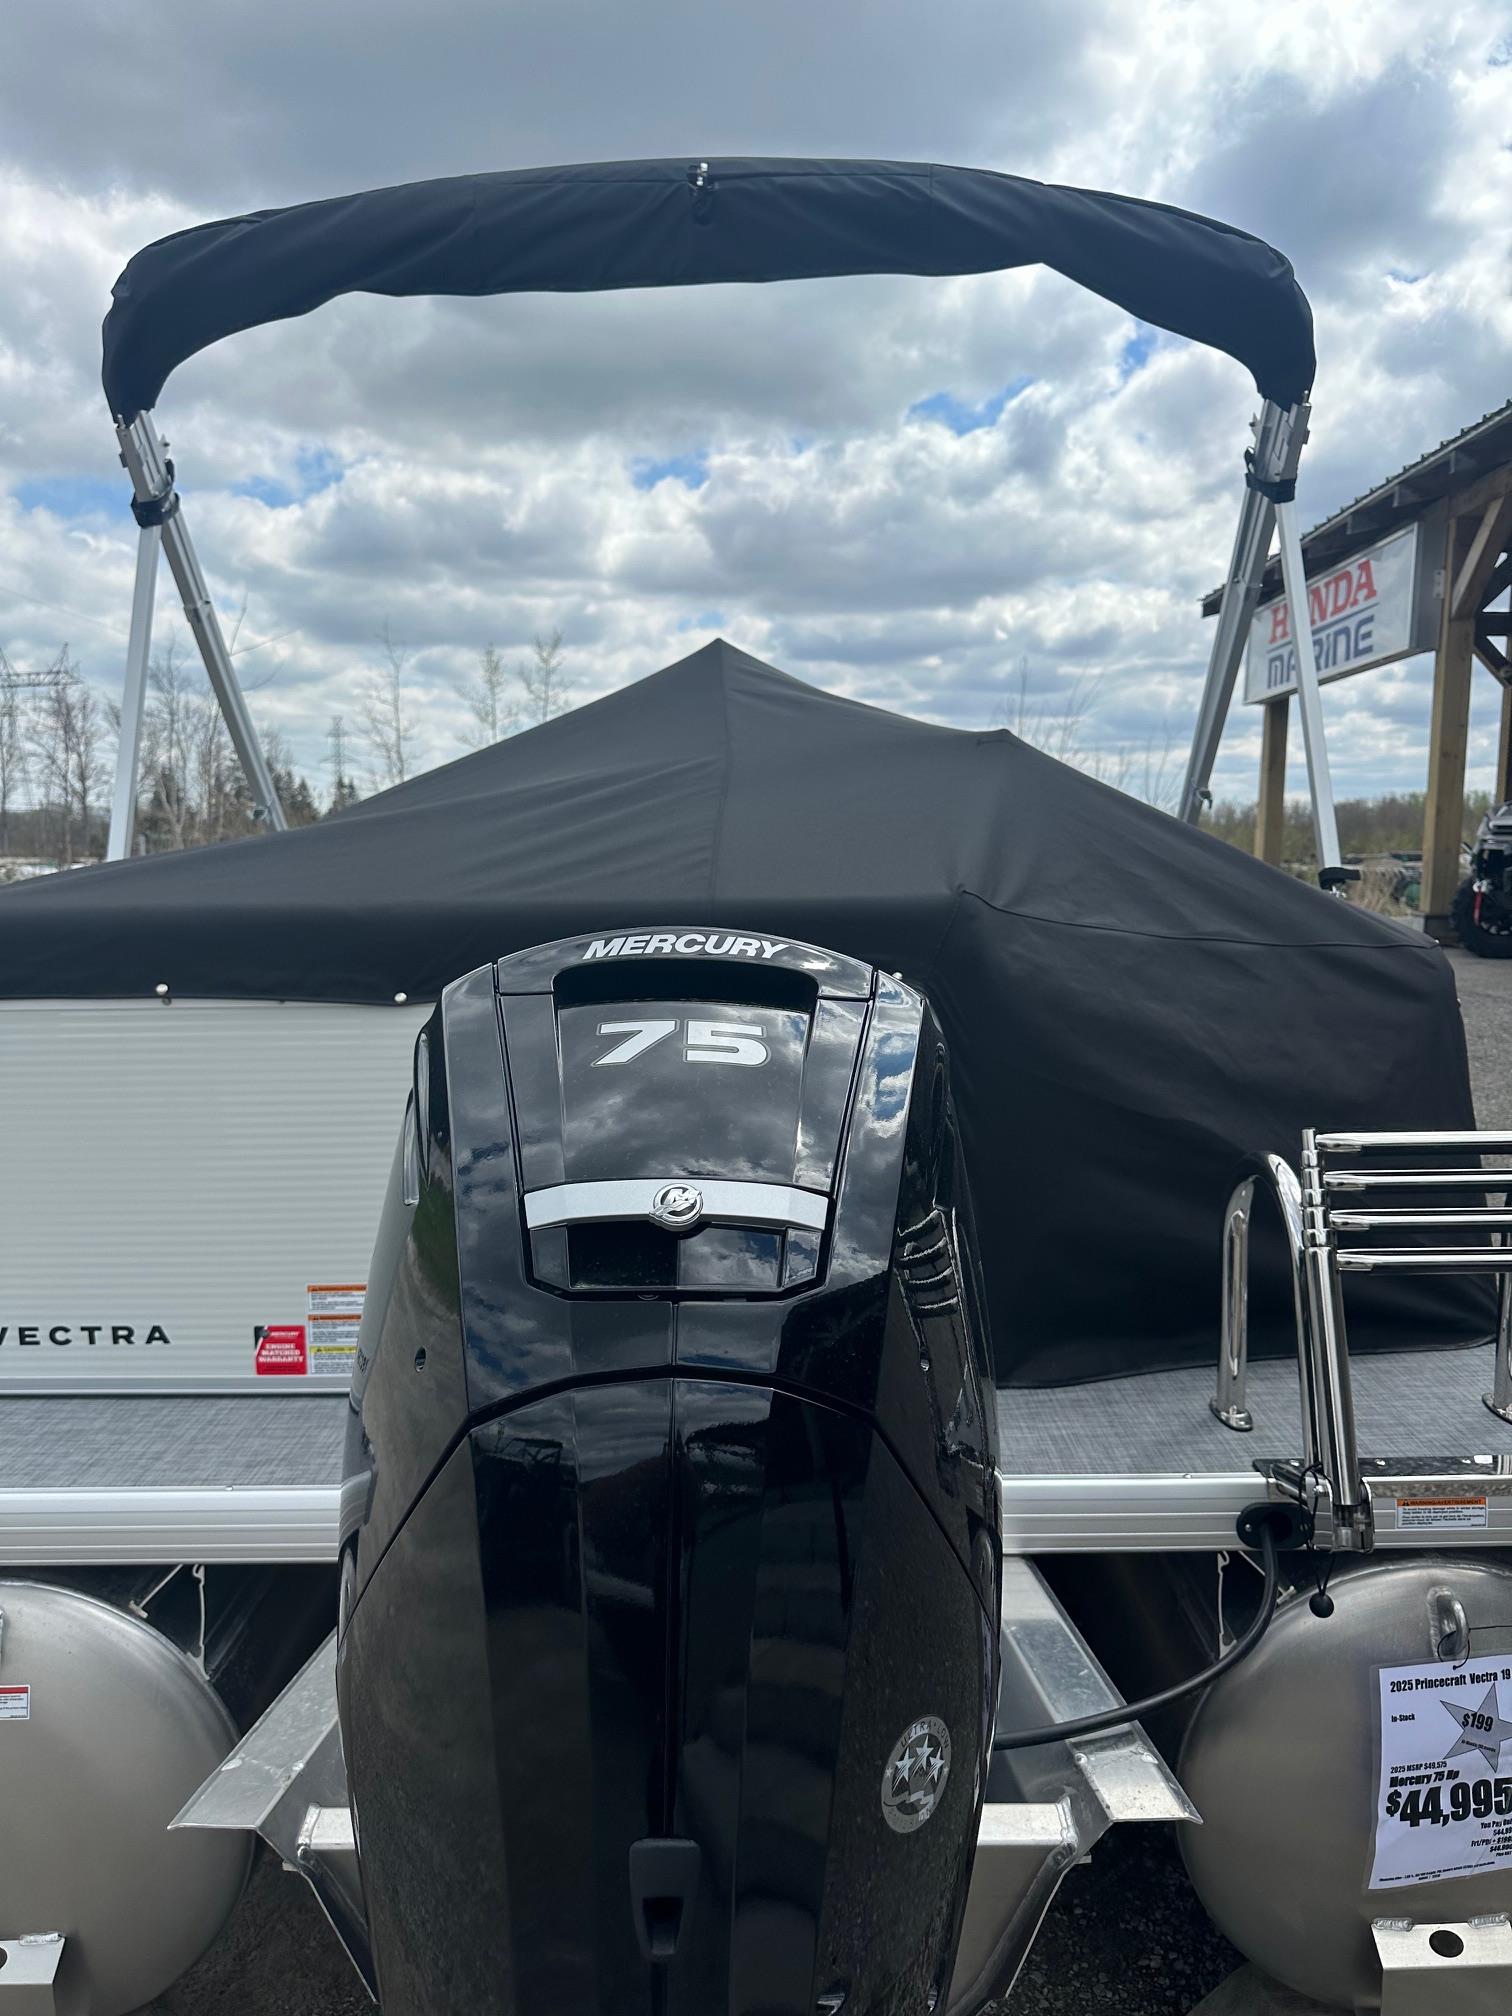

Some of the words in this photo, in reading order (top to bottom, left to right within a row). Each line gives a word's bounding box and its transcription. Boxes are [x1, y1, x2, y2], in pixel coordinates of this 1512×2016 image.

[1269, 559, 1377, 645] HNDA
[582, 934, 790, 960] MERCURY
[591, 1019, 771, 1067] 75
[1390, 1679, 1414, 1693] 2025
[1414, 1674, 1467, 1690] Princecraft
[1469, 1671, 1498, 1684] Vectra
[1500, 1668, 1511, 1680] 19
[1391, 1713, 1416, 1722] In-Stock
[1462, 1711, 1494, 1732] $199
[1389, 1774, 1432, 1788] Mercury
[1433, 1771, 1446, 1782] 75
[1390, 1765, 1406, 1774] 2025
[1406, 1762, 1423, 1772] MSRP
[1385, 1777, 1512, 1828] $44,995
